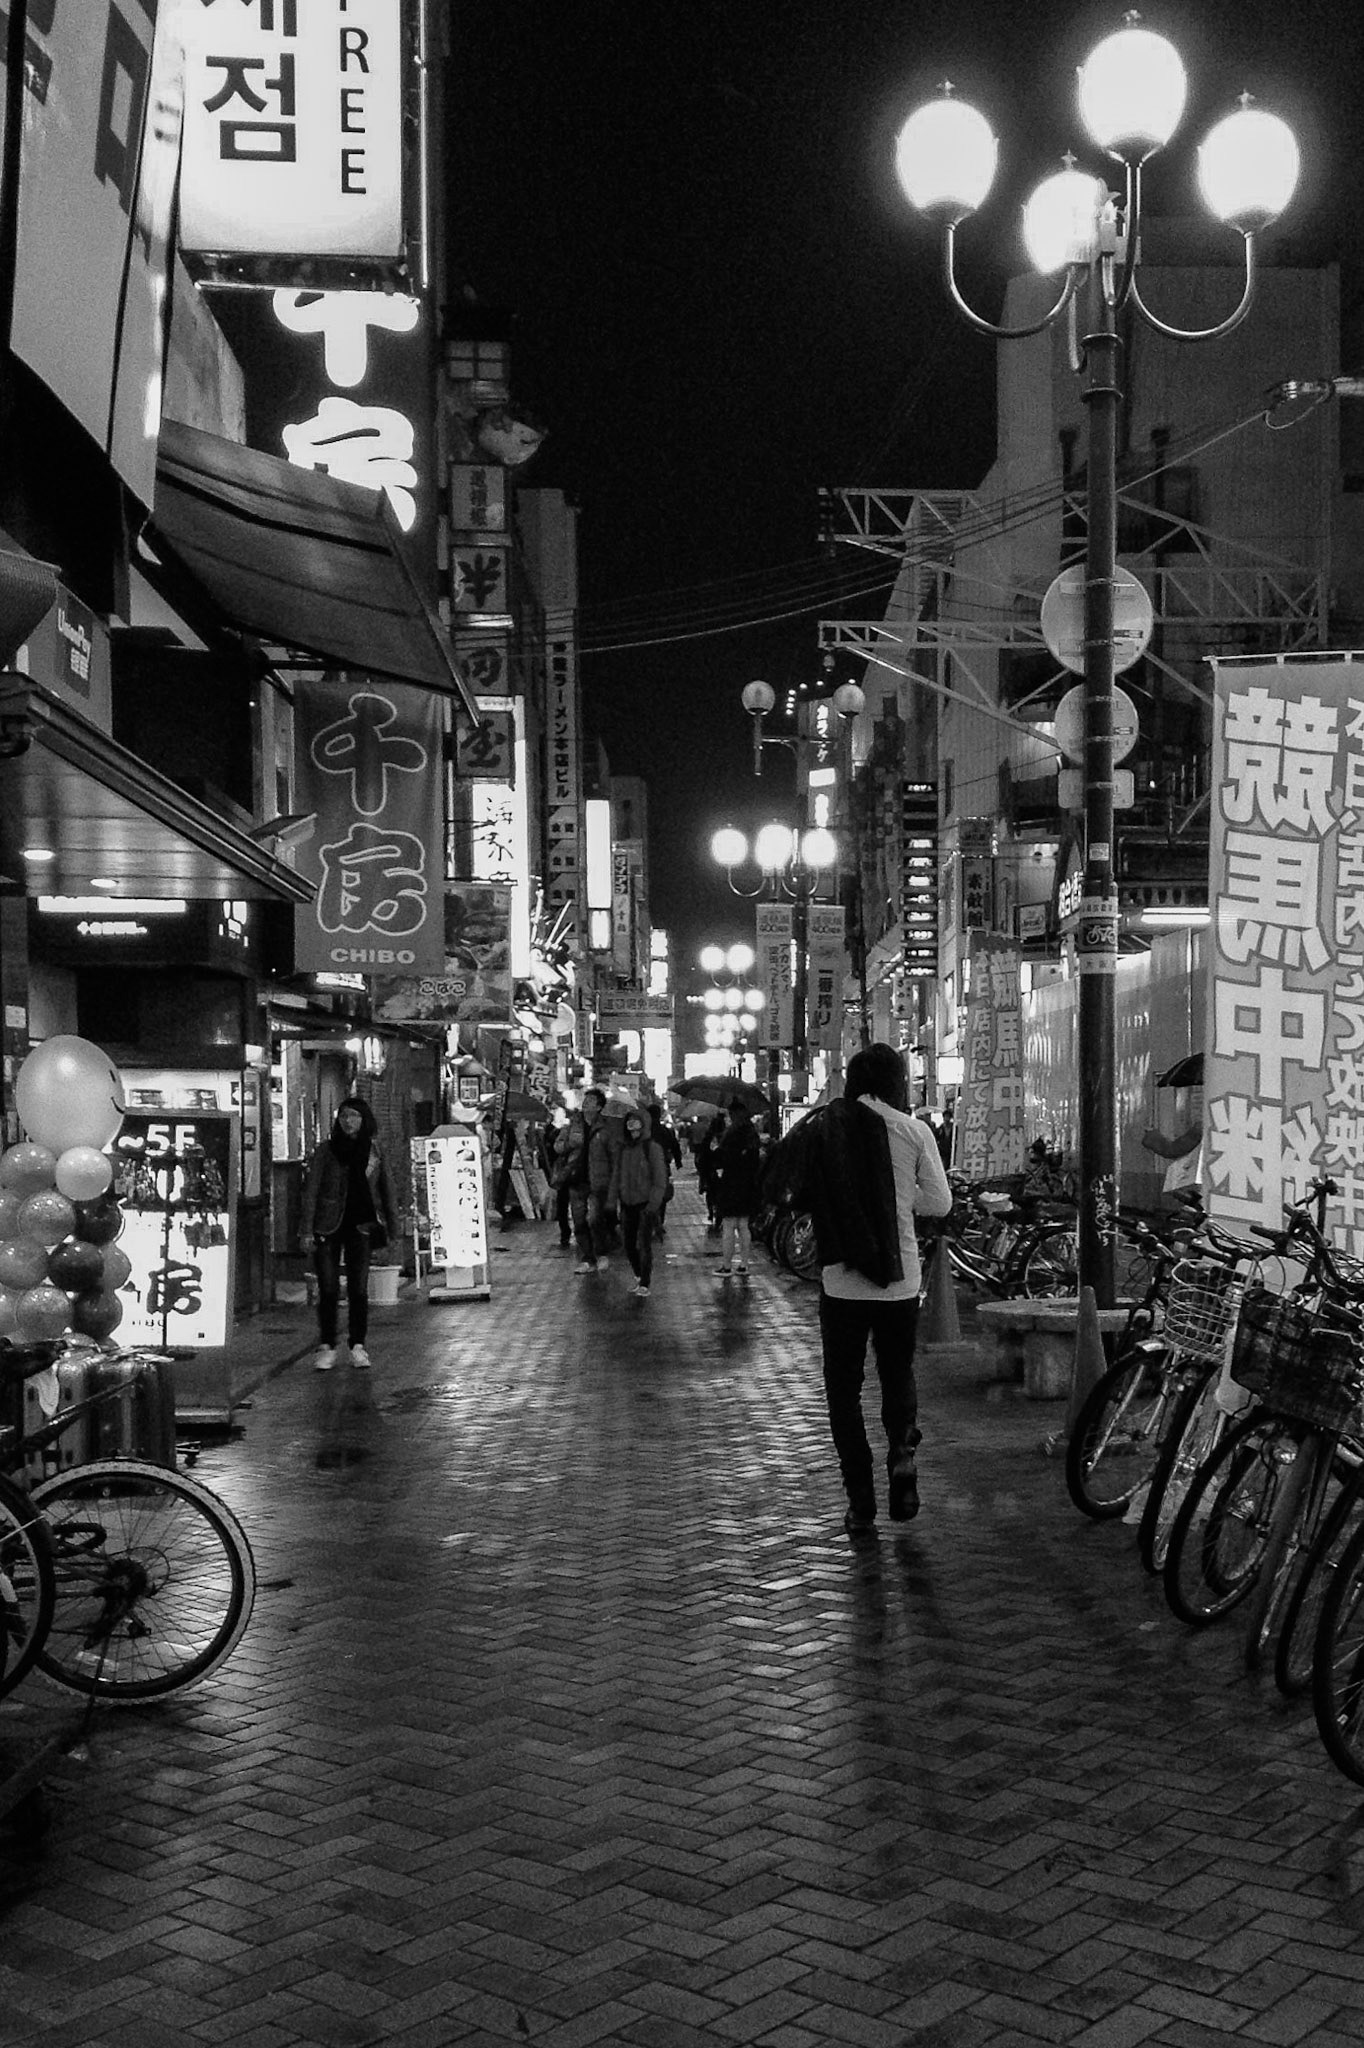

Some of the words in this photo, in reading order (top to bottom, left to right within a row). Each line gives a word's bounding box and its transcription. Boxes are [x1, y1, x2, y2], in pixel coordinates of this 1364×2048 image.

[339, 0, 370, 194] REE
[311, 692, 428, 936] 千房
[329, 948, 416, 965] CHIBO
[988, 947, 1025, 1176] 競馬中継
